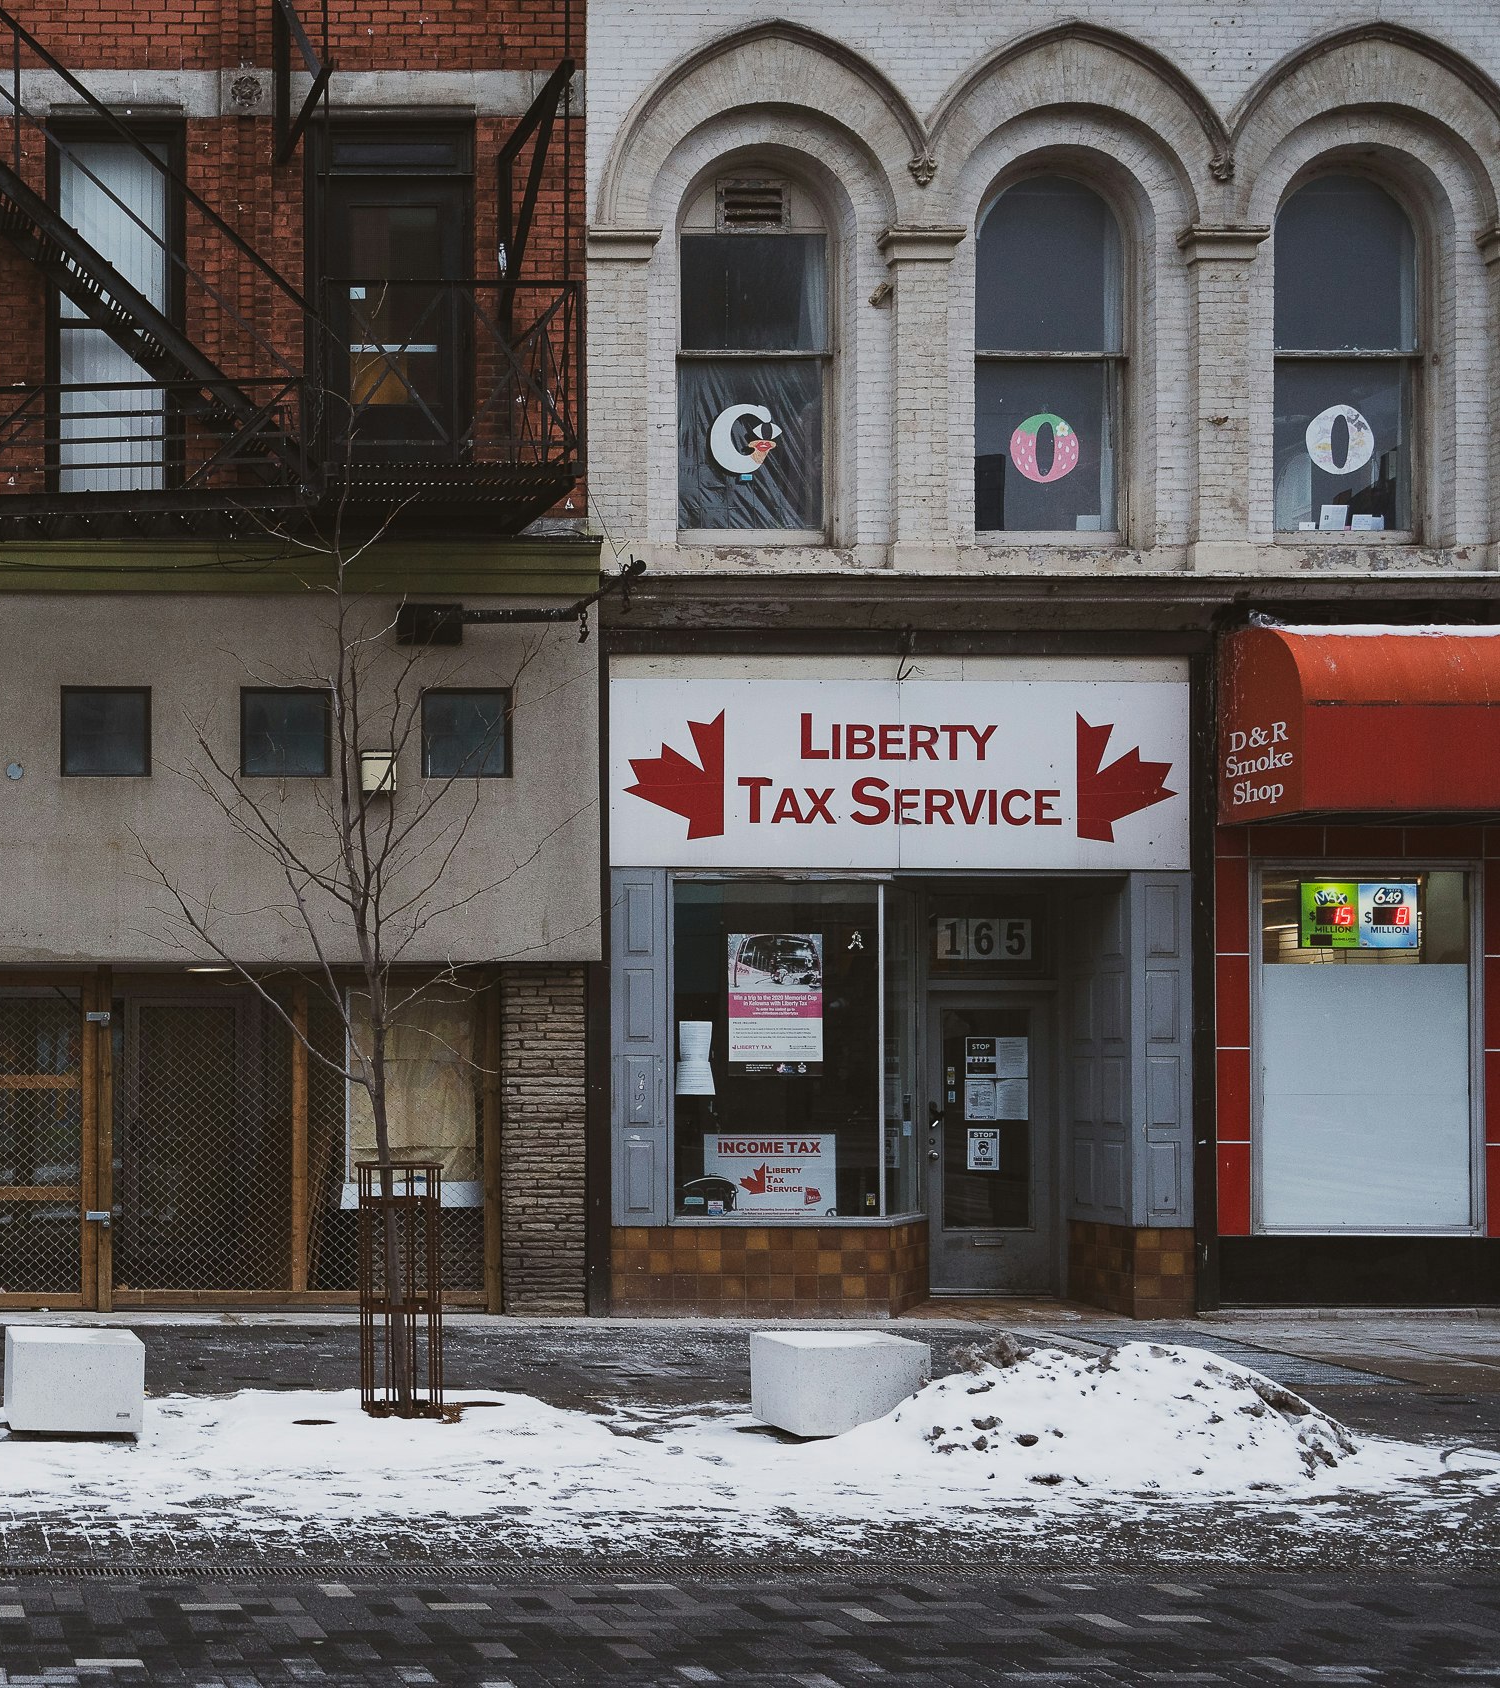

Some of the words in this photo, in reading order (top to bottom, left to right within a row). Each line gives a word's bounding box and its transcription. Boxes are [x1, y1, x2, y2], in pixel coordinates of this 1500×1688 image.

[1010, 412, 1080, 483] O
[1305, 404, 1375, 475] O
[800, 712, 998, 761] LIBERTY
[1225, 747, 1293, 778] Smoke
[737, 777, 837, 825] TAX
[850, 776, 1062, 826] SERVICE
[1232, 780, 1284, 805] Shop
[1314, 889, 1348, 905] MAX
[1309, 910, 1316, 922] $
[1335, 907, 1351, 925] 15
[1364, 911, 1372, 923] $
[1396, 907, 1407, 925] 8
[944, 921, 1026, 956] 165
[1314, 926, 1352, 934] MILLION
[1370, 926, 1410, 934] MILLION
[717, 1142, 784, 1154] INCOME
[787, 1142, 821, 1154] TAX
[766, 1165, 802, 1174] LIBERTY
[766, 1175, 785, 1184] TAX
[766, 1185, 803, 1193] SERVICE
